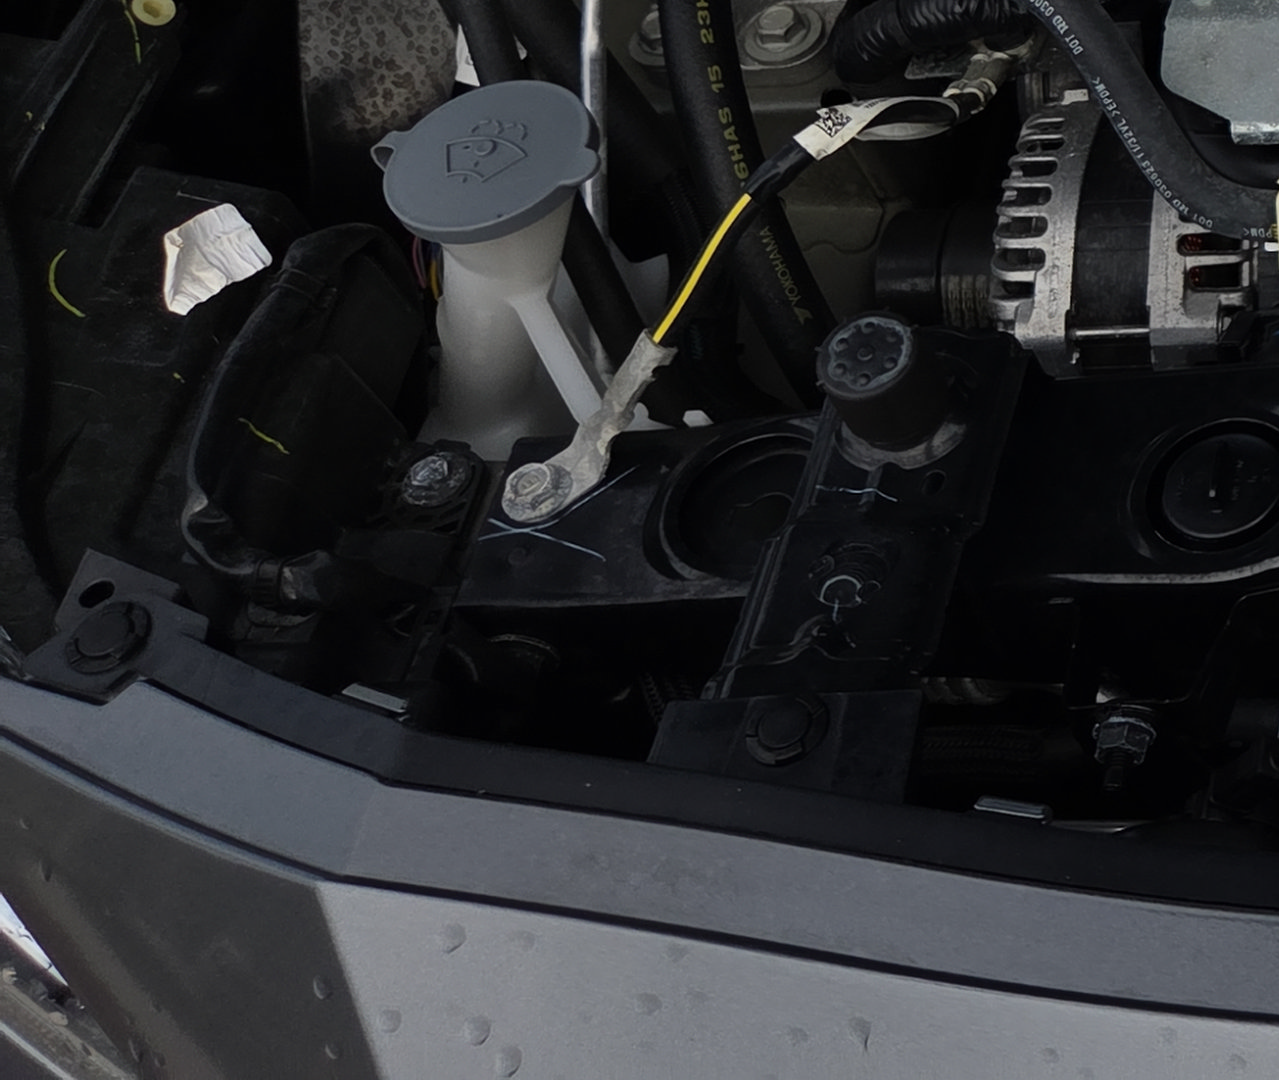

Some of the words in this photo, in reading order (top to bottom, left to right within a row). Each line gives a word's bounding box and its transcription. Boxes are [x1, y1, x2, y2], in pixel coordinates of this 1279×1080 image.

[1064, 33, 1084, 56] DOT
[706, 63, 726, 94] 15
[759, 224, 803, 306] YOKOHAMA
